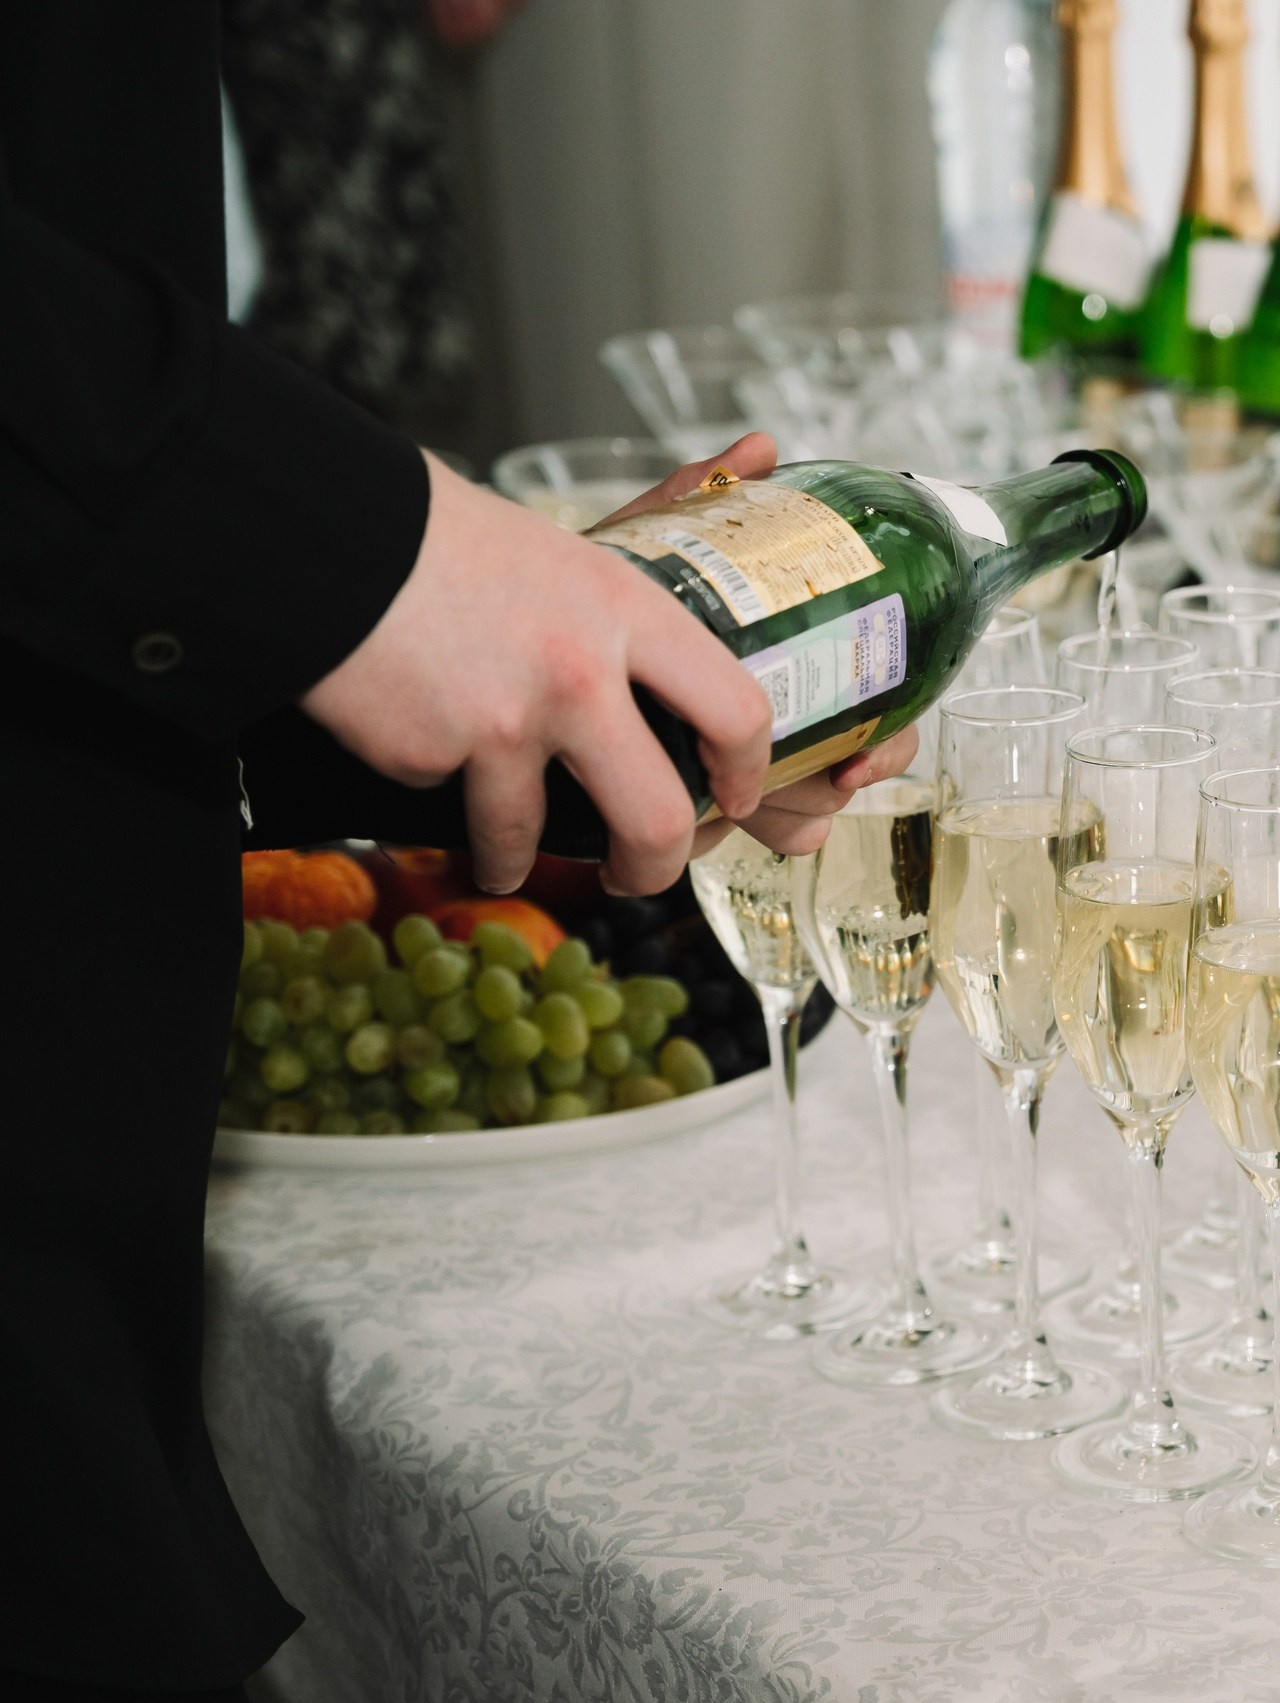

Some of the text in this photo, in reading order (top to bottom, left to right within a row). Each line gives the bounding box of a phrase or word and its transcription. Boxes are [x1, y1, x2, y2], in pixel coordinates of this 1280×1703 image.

[862, 617, 871, 693] ФЕДЕРАЛЬНАЯ
[886, 609, 894, 681] ФЕДЕРАЦИЯ
[891, 607, 899, 679] РОССИЙСКАЯ
